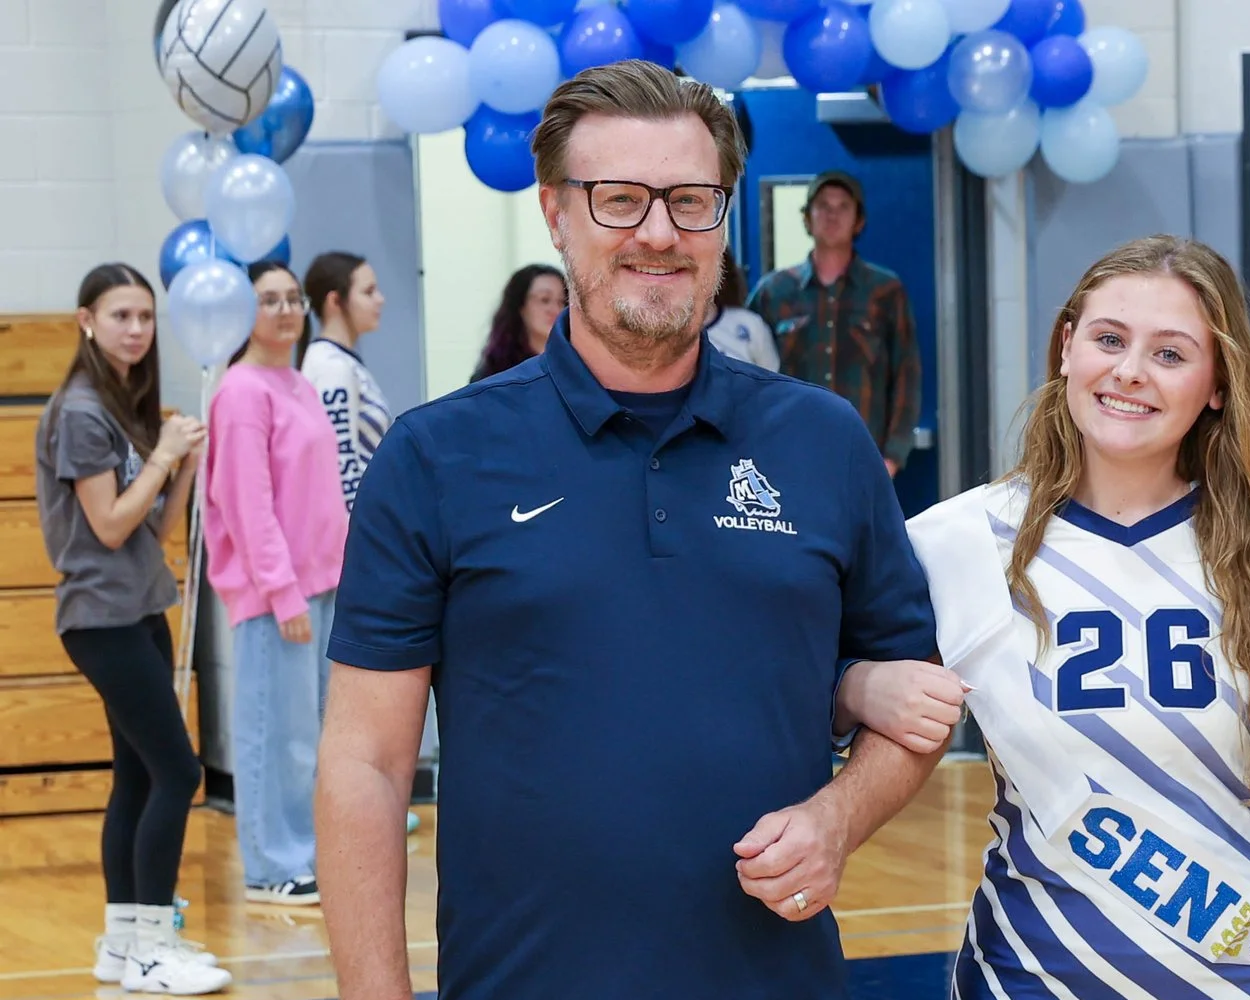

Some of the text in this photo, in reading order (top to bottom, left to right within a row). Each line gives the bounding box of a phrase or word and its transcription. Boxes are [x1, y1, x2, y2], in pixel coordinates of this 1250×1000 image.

[734, 479, 757, 501] M
[714, 516, 797, 534] VOLLEYBALL
[1056, 608, 1218, 712] 26
